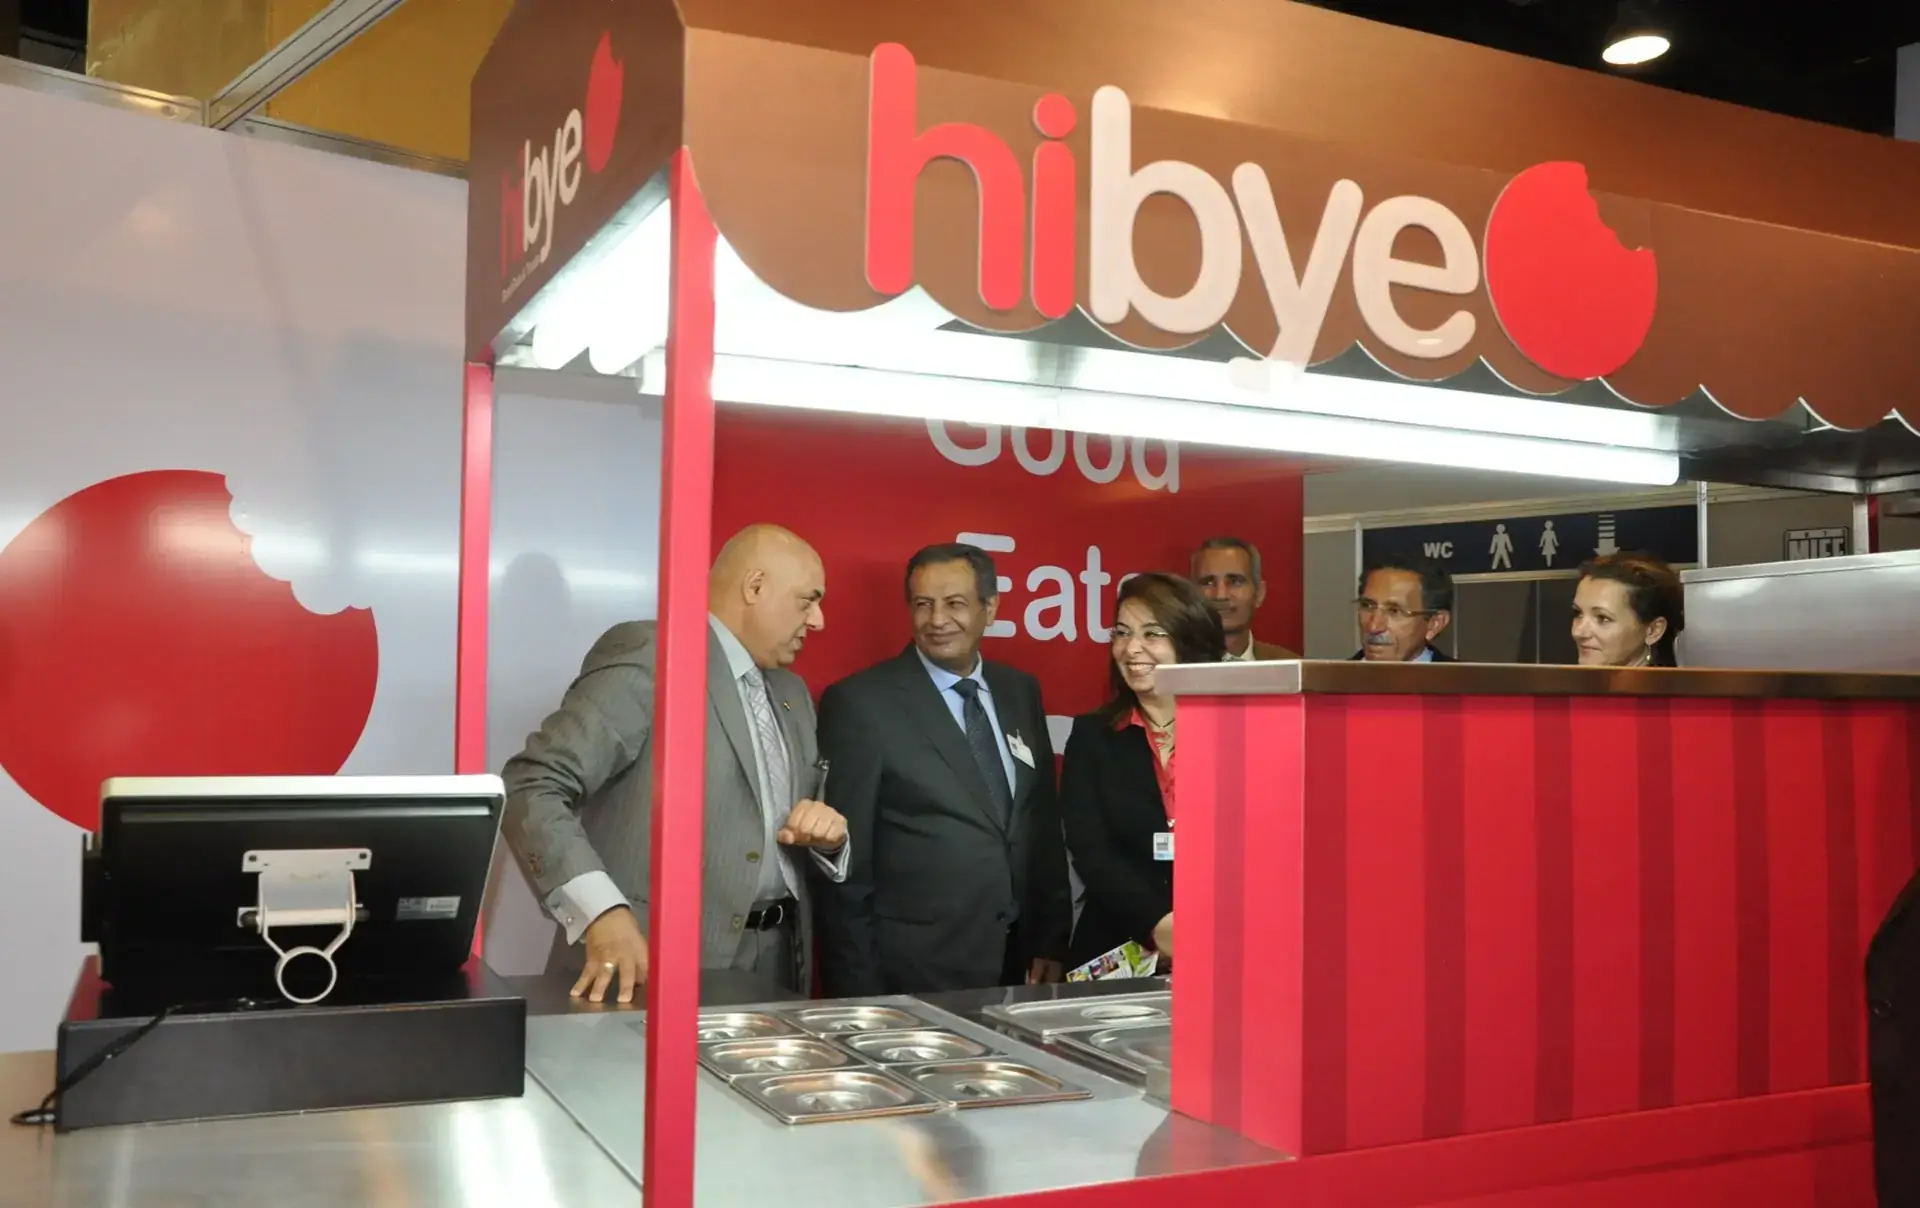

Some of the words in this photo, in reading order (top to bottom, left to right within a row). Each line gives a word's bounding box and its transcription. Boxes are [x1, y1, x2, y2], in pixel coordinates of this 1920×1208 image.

[501, 108, 582, 279] hibye
[865, 41, 1479, 392] hibye
[955, 531, 1146, 644] Eat
[1423, 542, 1454, 559] WC
